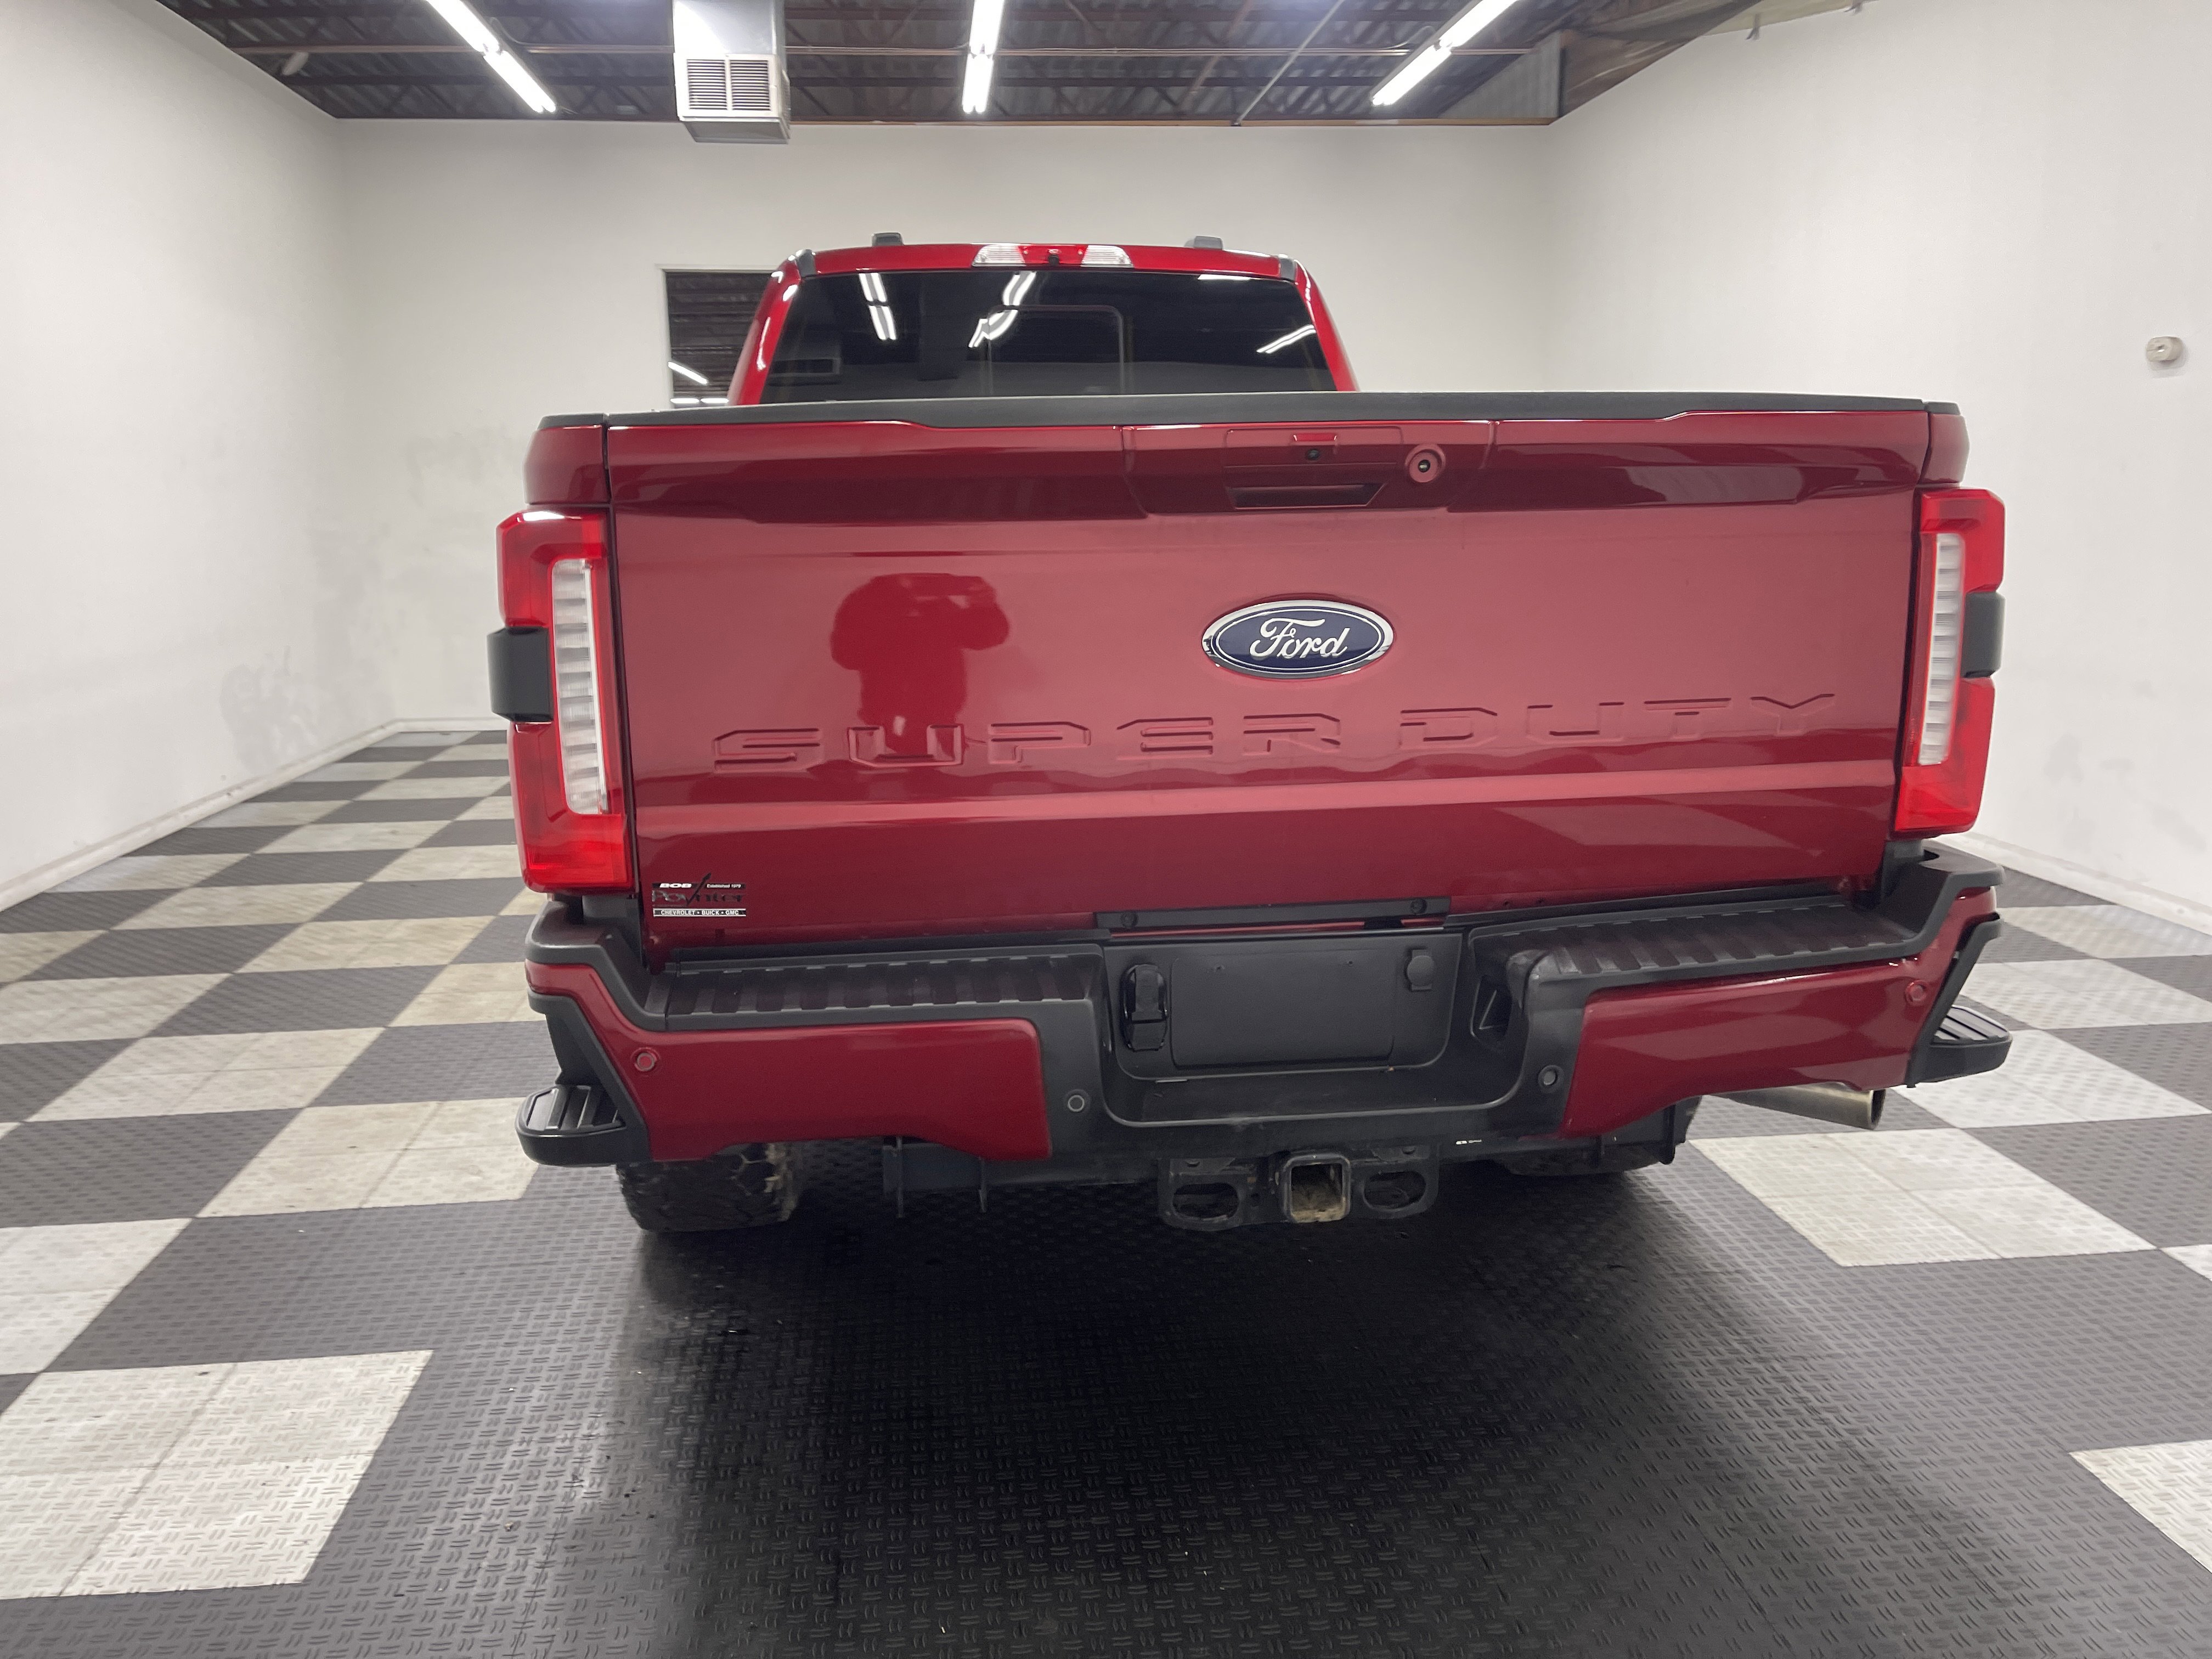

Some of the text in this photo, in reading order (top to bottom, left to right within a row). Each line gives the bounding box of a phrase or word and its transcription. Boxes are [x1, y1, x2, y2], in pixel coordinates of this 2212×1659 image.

[1249, 617, 1351, 659] Ford
[713, 693, 1836, 772] SUPER DUTY
